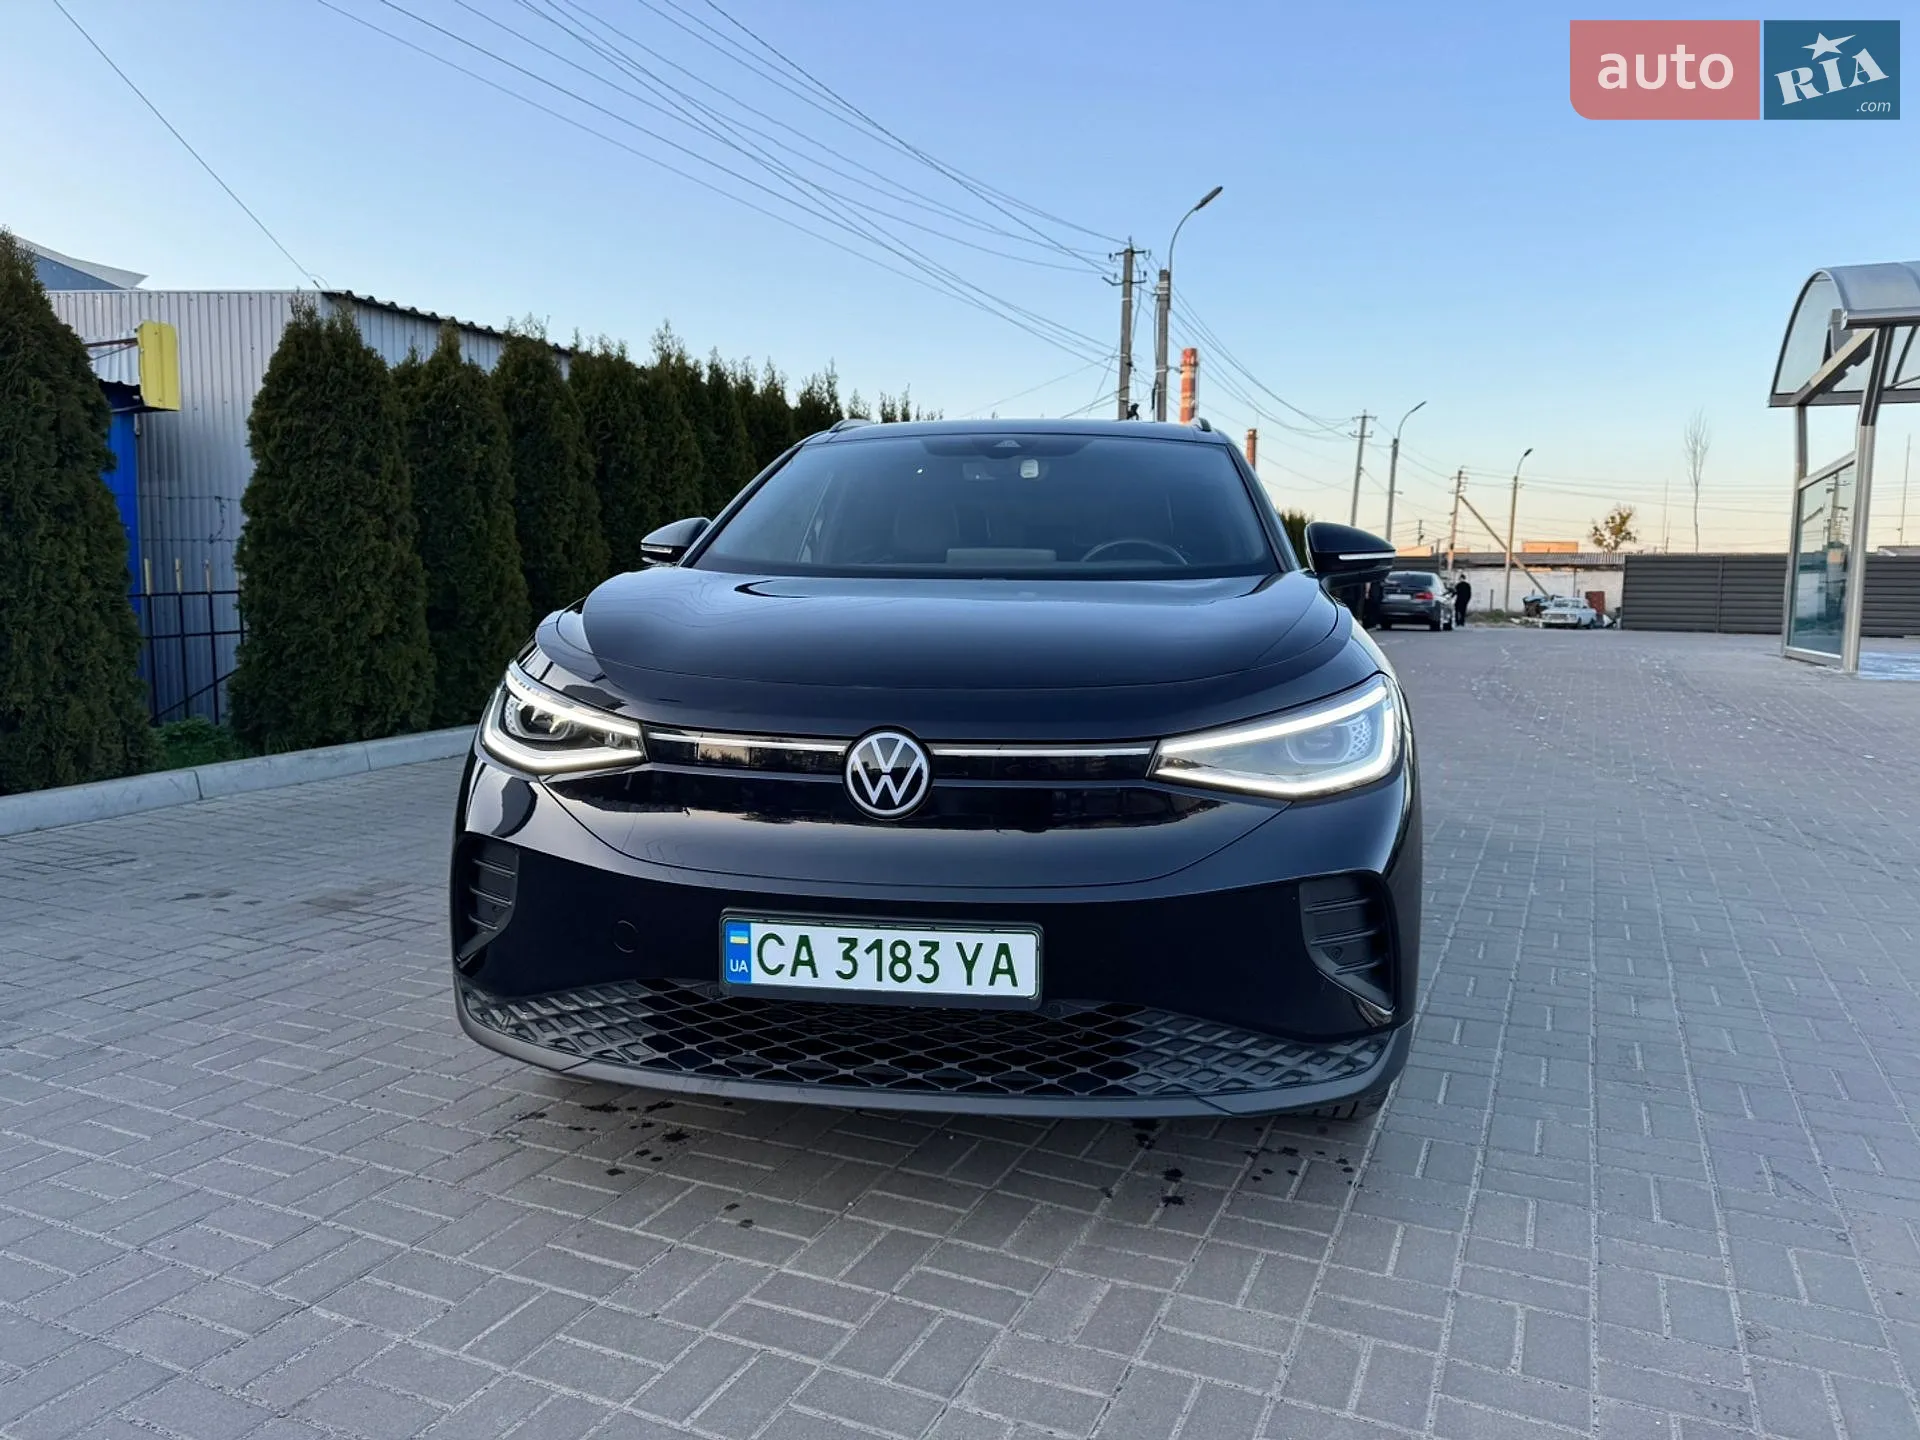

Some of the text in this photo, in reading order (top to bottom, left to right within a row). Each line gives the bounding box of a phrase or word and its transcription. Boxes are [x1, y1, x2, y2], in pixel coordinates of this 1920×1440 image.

[729, 959, 749, 973] UA
[757, 932, 1019, 987] CA 3183 YA
